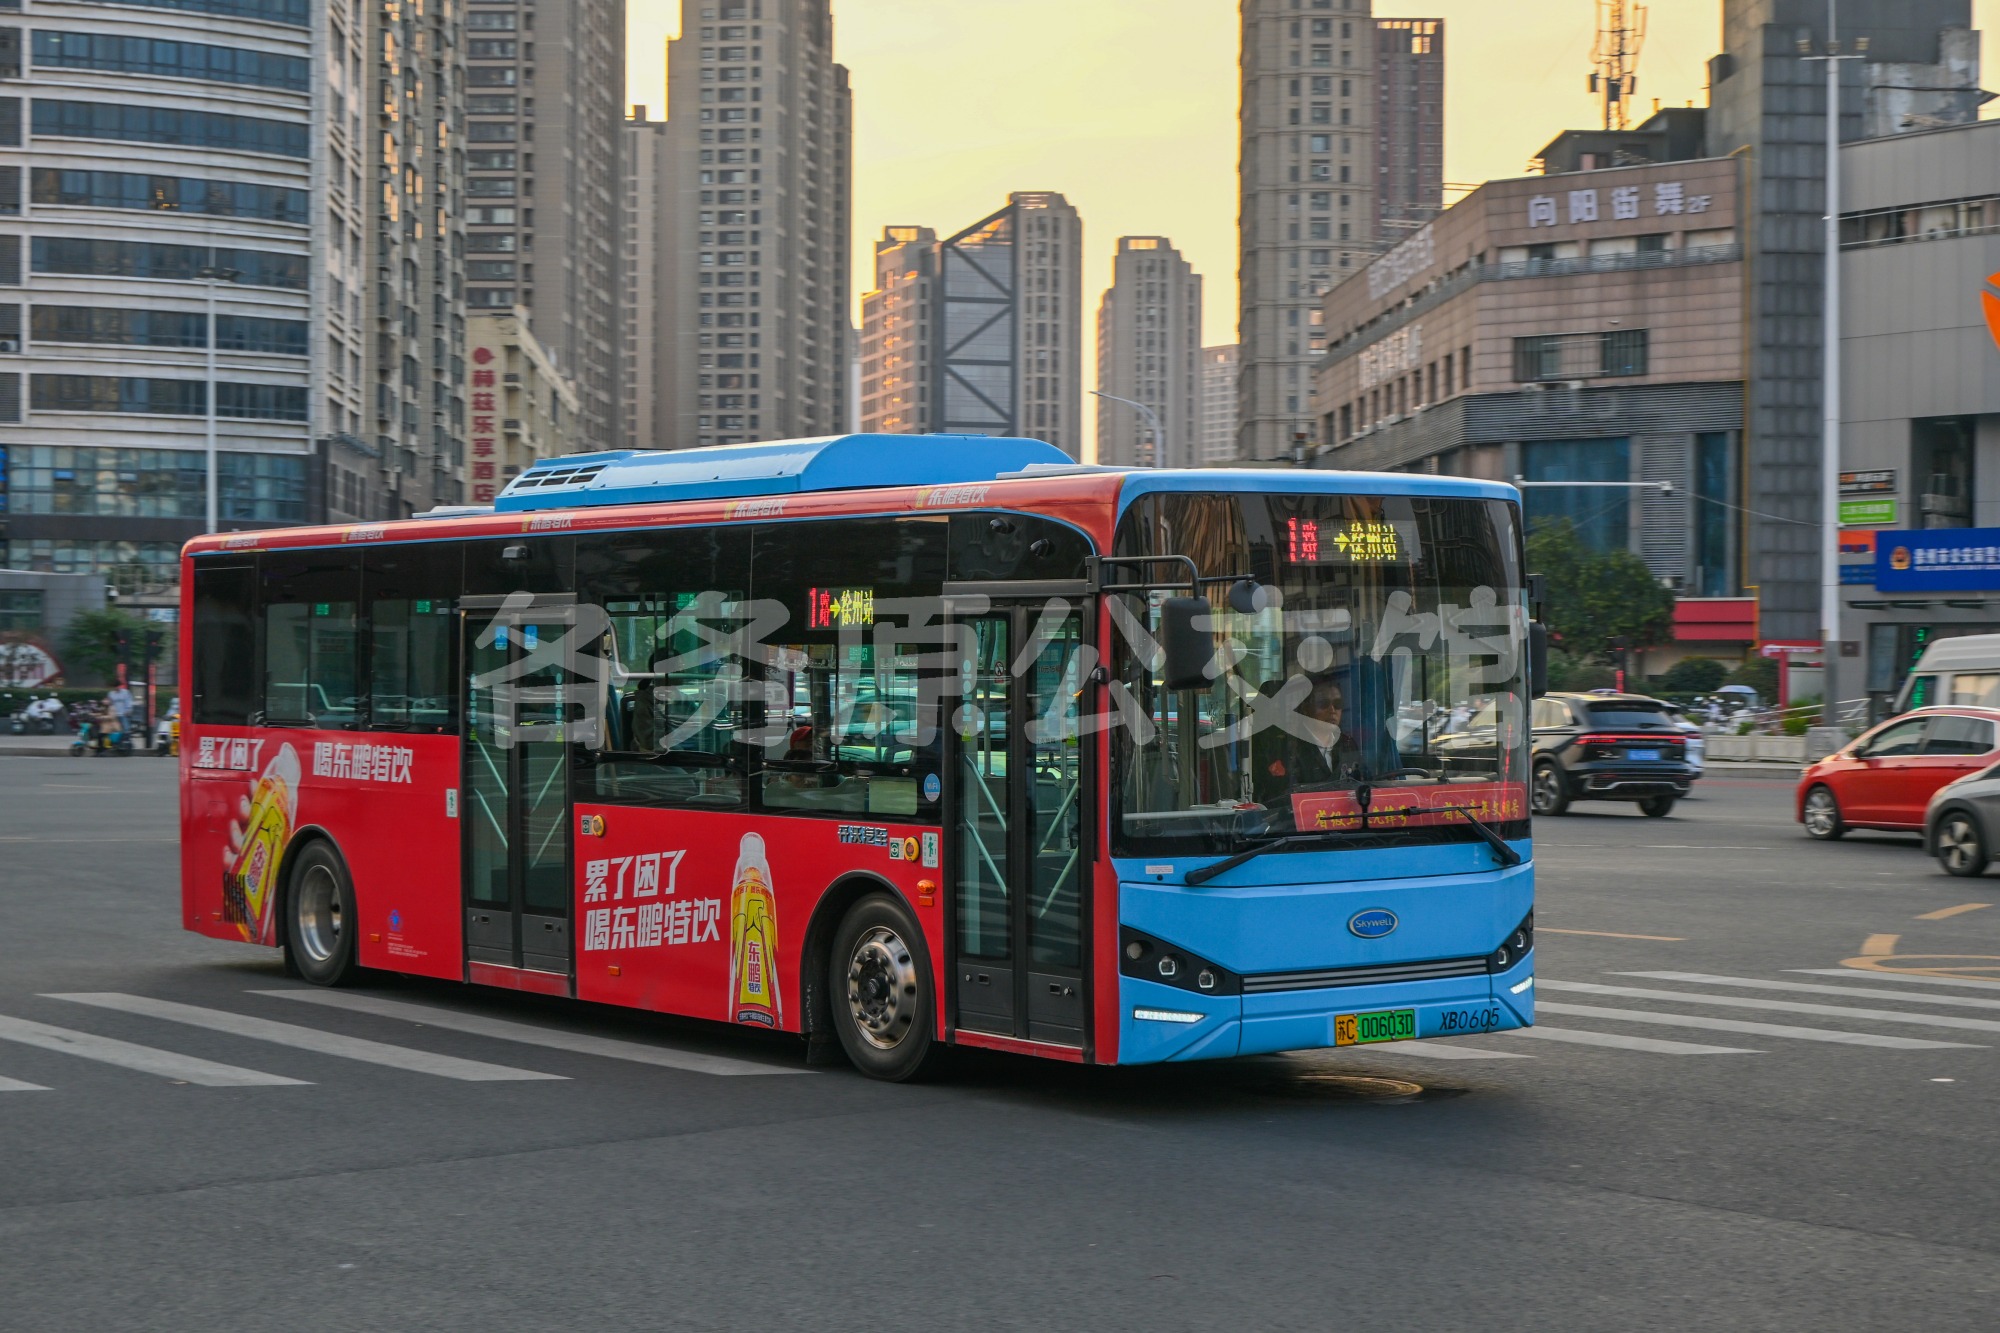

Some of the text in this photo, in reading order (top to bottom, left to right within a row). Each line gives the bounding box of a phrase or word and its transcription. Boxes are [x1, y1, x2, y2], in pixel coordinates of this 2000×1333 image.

[1528, 182, 1712, 228] 向阳街舞 2F
[809, 587, 874, 628] 1路 徐州站
[198, 737, 265, 771] 累了困了
[313, 741, 413, 784] 喝东鹏特饮
[1314, 804, 1409, 827] 省级工先锋号
[838, 825, 888, 847] 开沃汽车
[585, 850, 686, 902] 累了困了
[584, 897, 720, 951] 喝东鹏特饮
[1355, 918, 1394, 928] Skywell
[748, 942, 761, 982] 东鹏
[1337, 1013, 1414, 1041] 苏C 00603D
